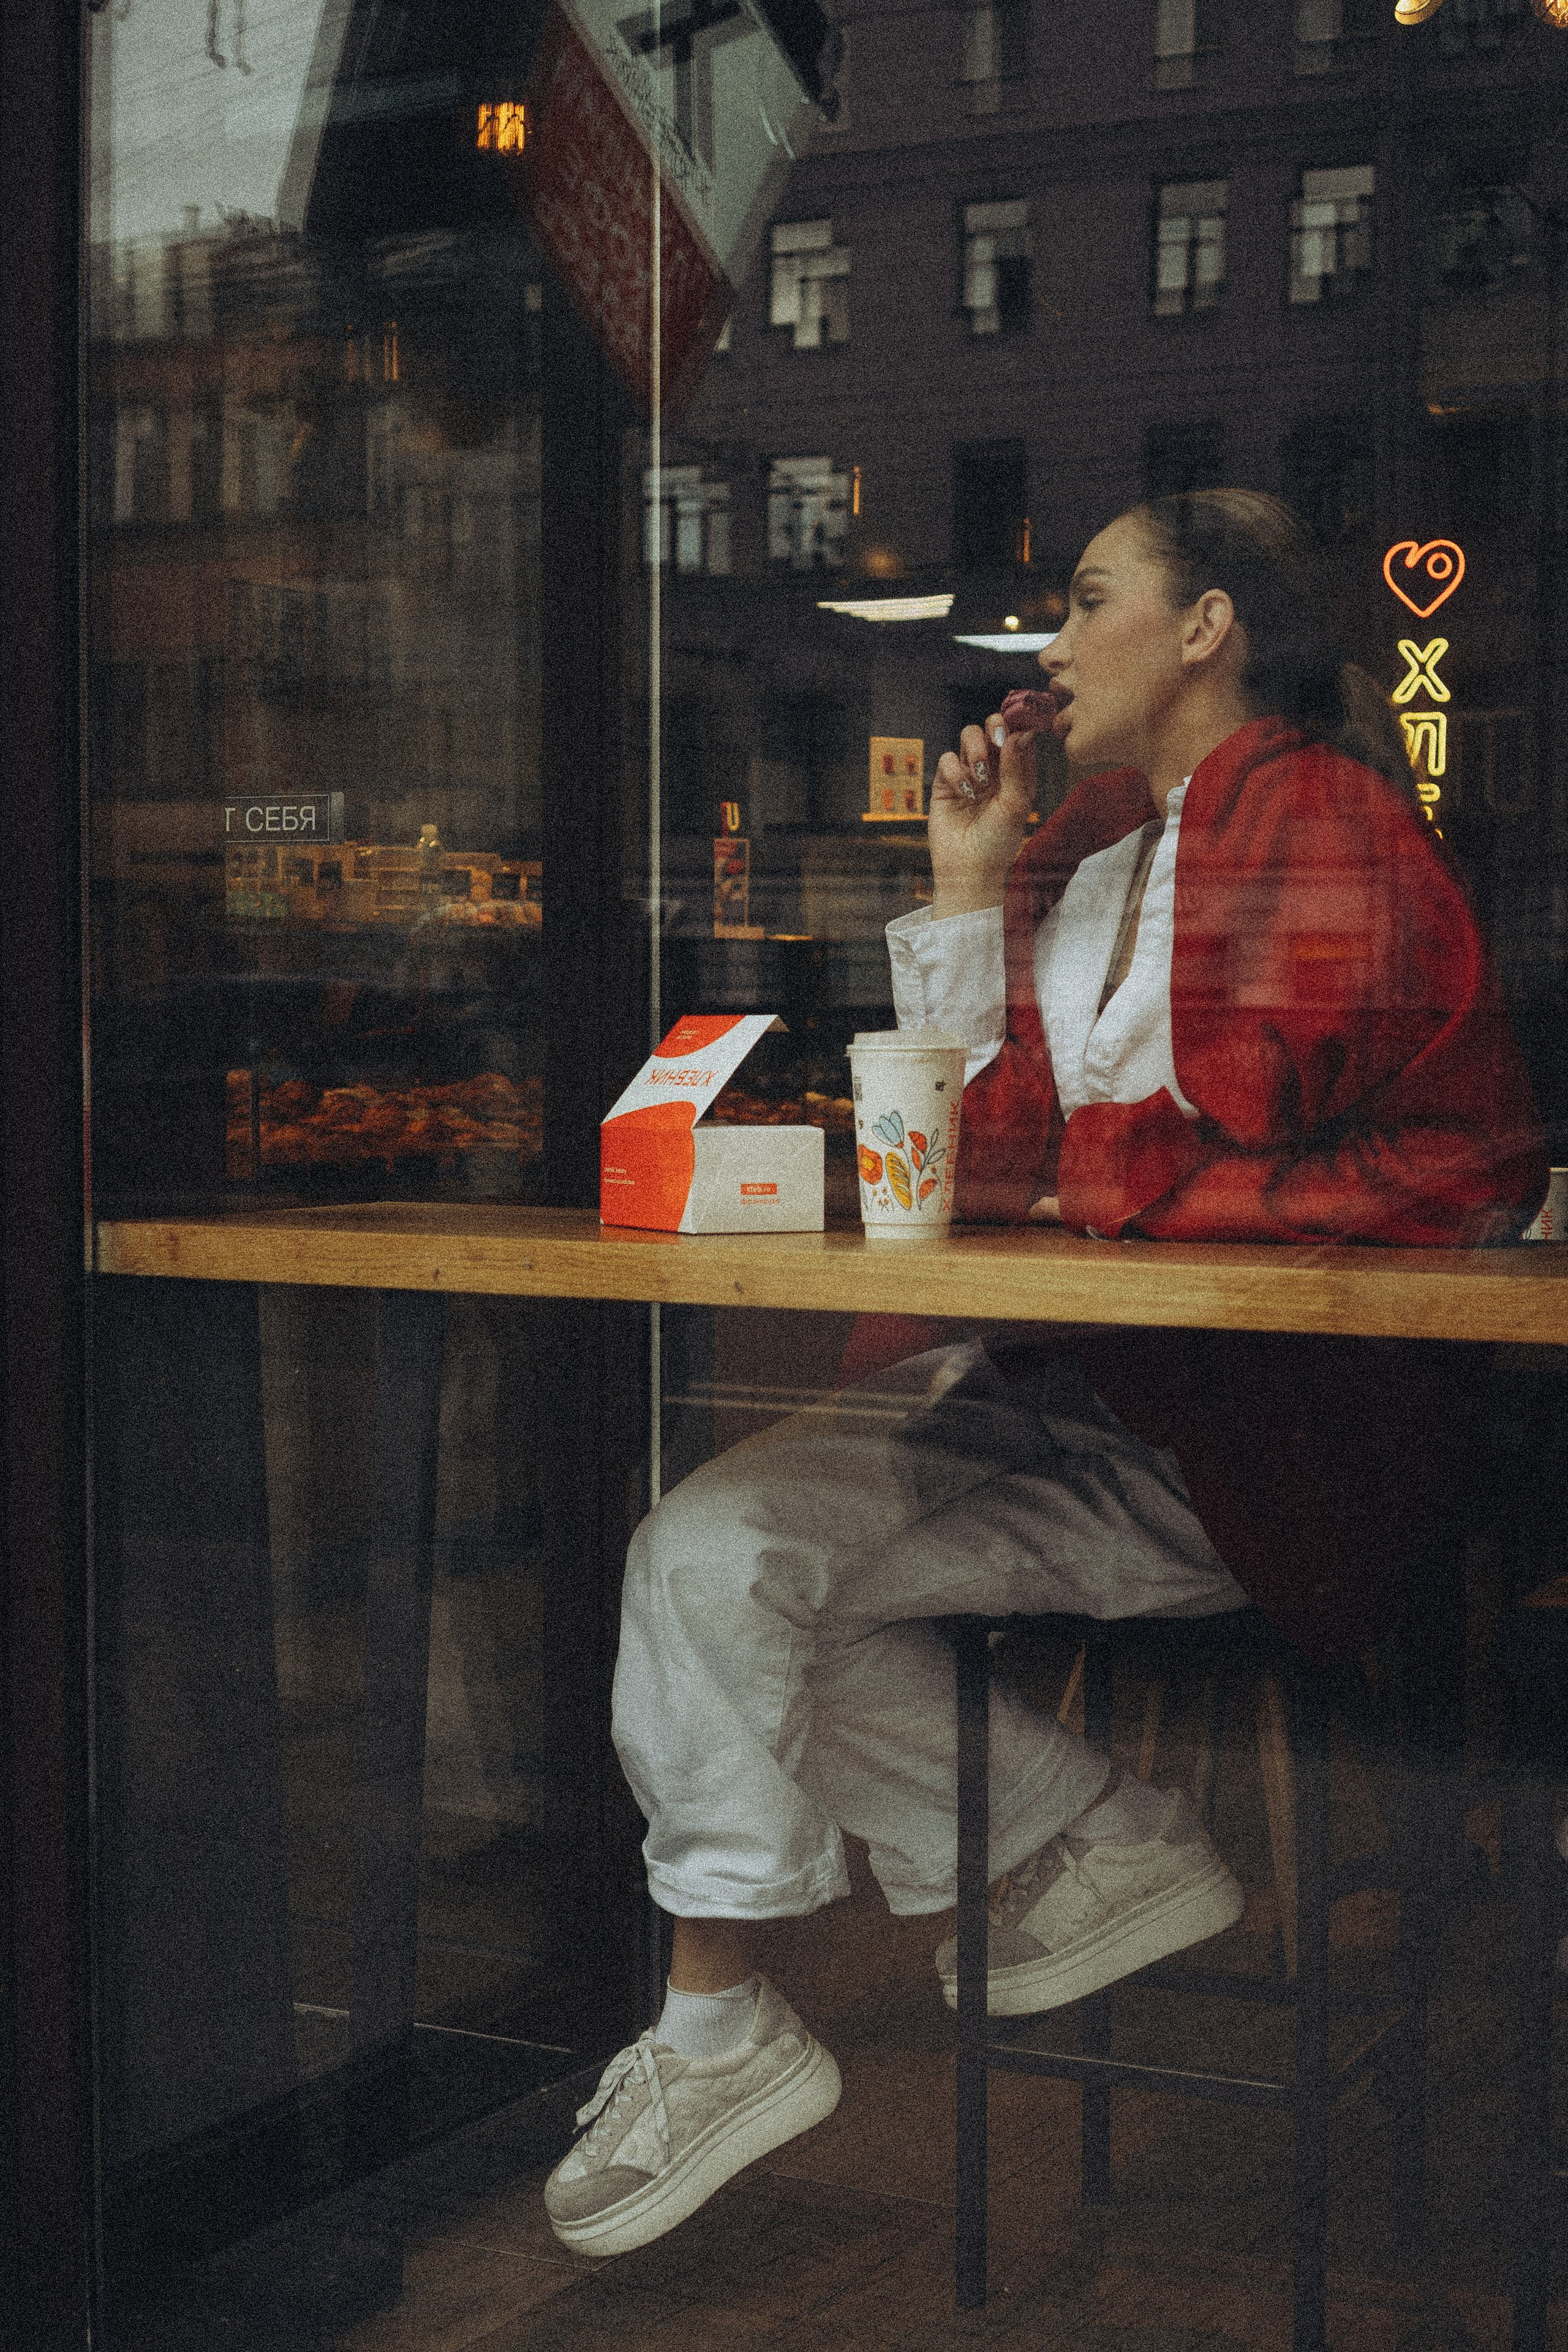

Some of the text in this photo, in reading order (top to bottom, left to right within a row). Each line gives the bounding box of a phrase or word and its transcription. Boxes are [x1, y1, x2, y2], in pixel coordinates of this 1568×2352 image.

[246, 806, 315, 832] СЕБЯ
[644, 1069, 719, 1087] ХЛЕБНИК
[942, 1101, 960, 1211] ХЛЕБНИК
